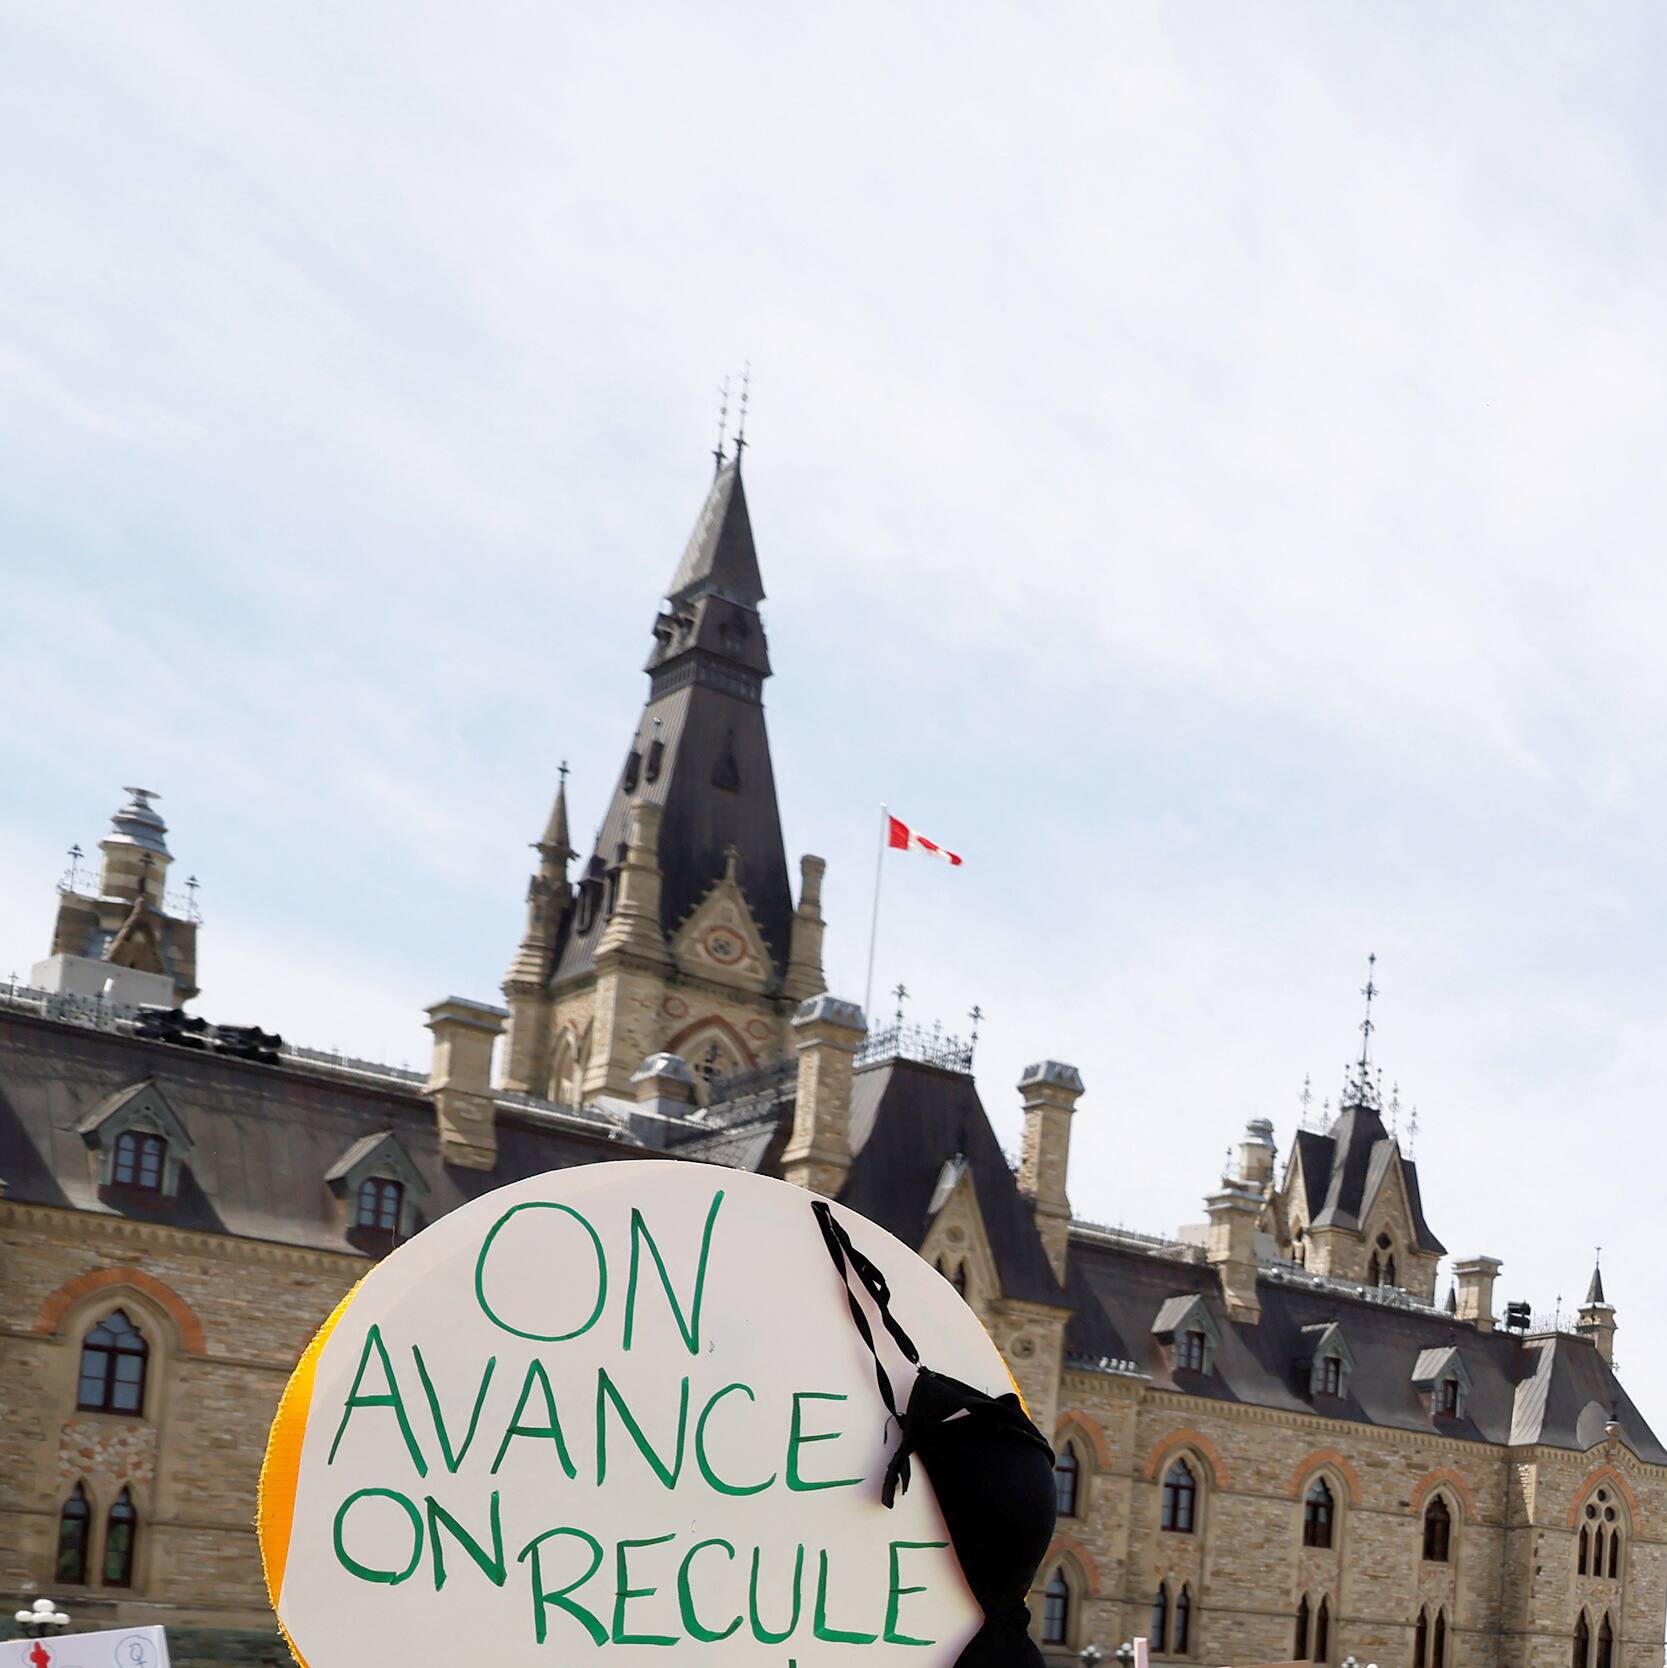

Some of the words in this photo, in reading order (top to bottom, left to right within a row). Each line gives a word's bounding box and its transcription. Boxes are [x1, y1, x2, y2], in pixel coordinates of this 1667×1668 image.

[475, 1190, 725, 1355] ON
[328, 1325, 864, 1496] AVANCE
[333, 1487, 507, 1591] ON
[518, 1527, 949, 1647] RECULE
